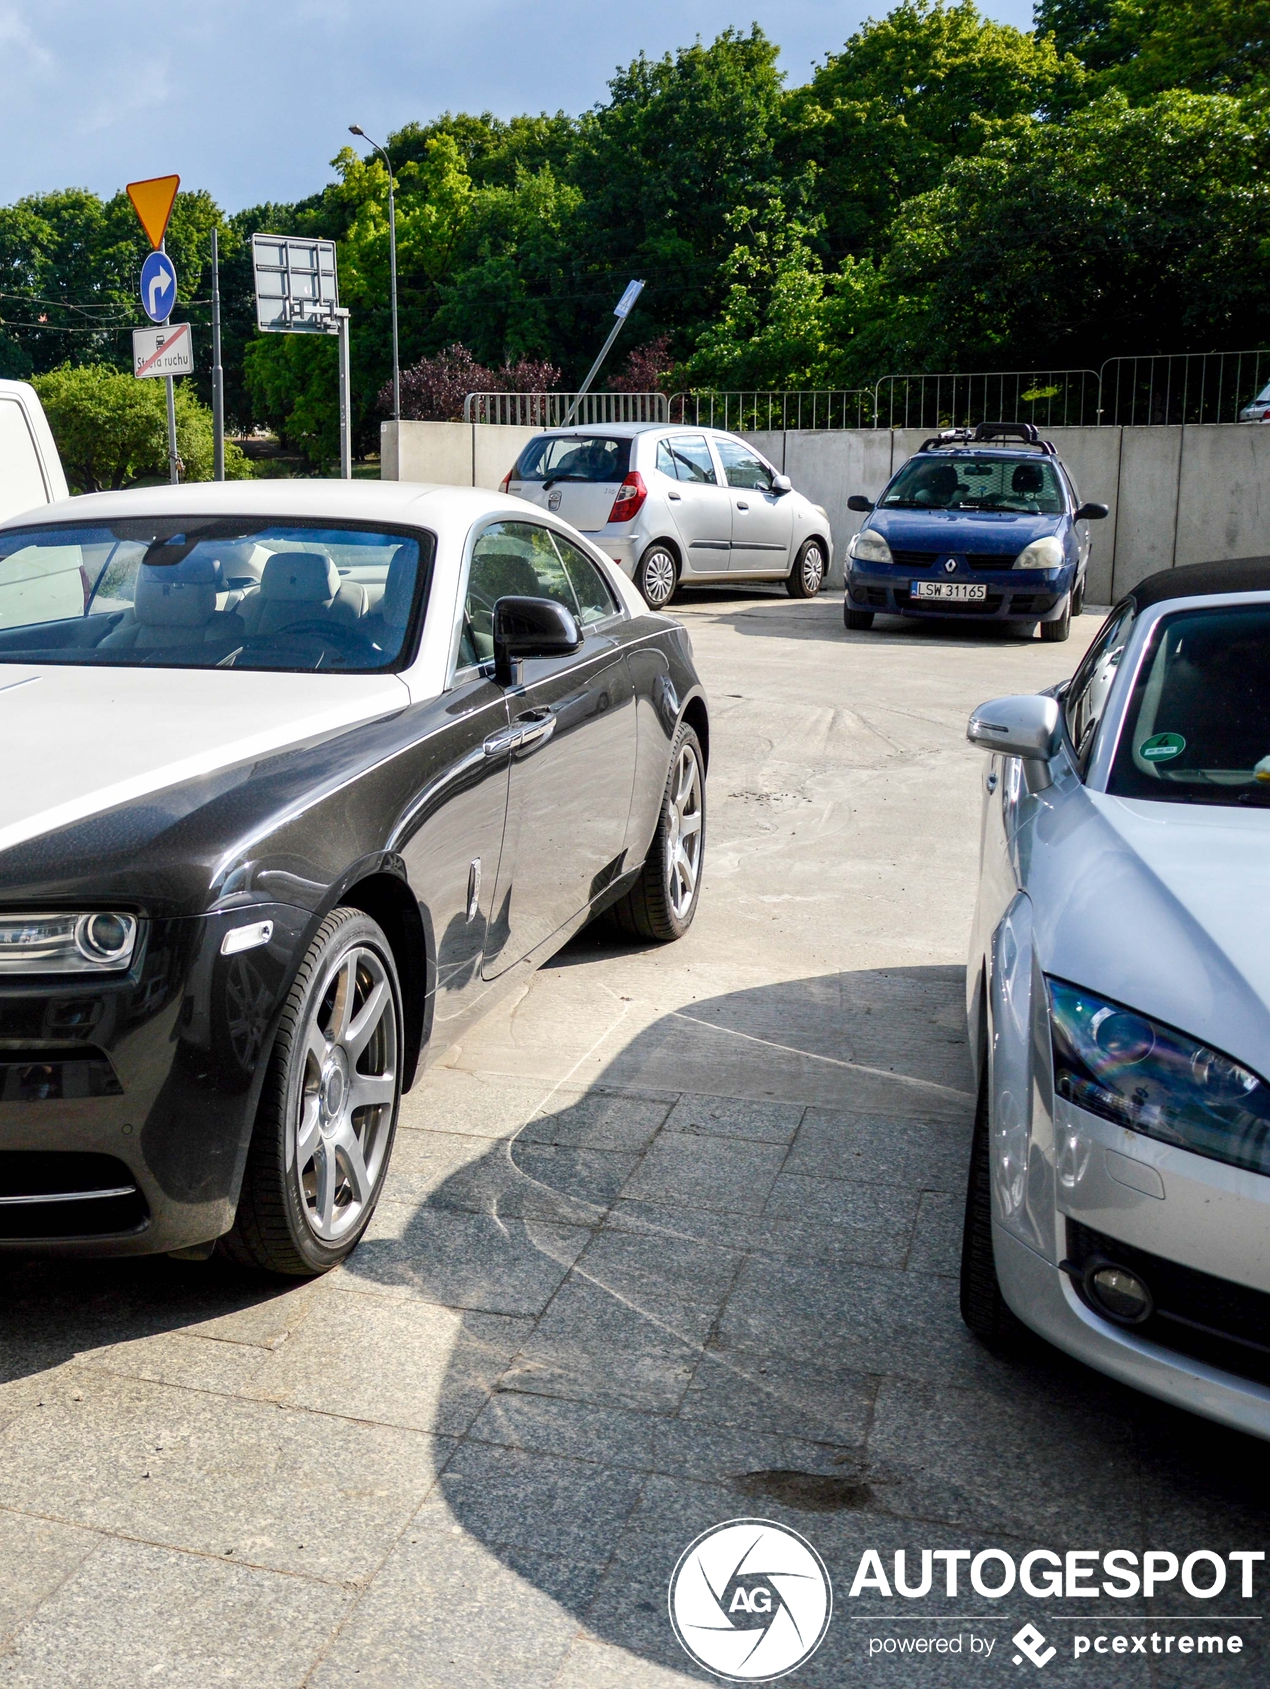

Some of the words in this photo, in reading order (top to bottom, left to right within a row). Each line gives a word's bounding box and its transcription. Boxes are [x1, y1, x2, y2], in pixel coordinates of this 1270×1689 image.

[137, 356, 162, 369] Stfa
[165, 353, 188, 366] ruchu
[918, 583, 942, 596] LSW
[945, 585, 984, 598] 31165
